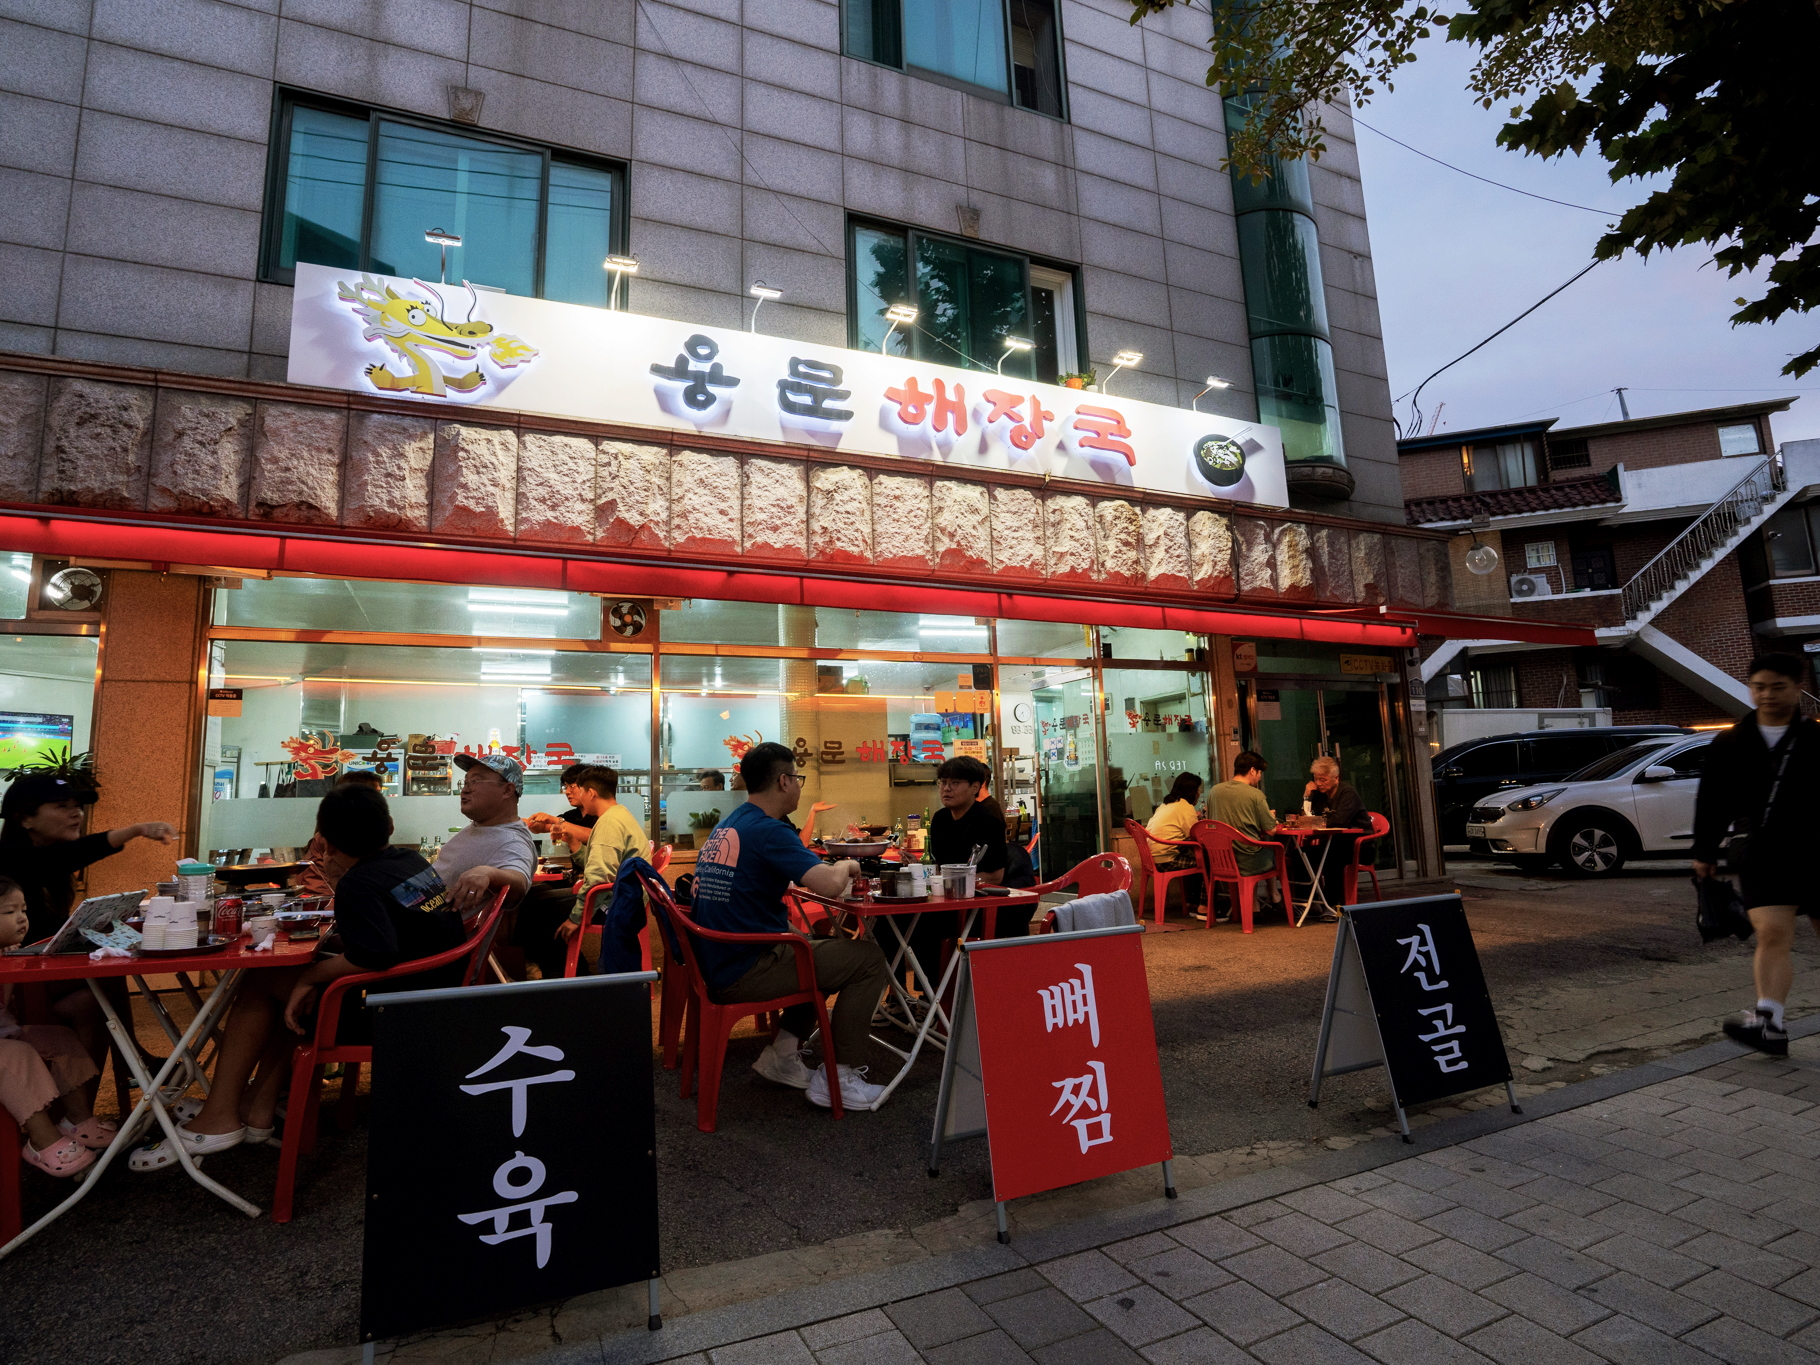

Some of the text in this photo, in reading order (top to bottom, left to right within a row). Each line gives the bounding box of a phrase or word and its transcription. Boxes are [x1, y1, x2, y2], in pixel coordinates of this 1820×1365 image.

[1411, 686, 1423, 695] 110
[420, 894, 445, 913] ocean
[1037, 962, 1114, 1155] 뼈찜
[1396, 923, 1469, 1073] 전골
[457, 1025, 579, 1269] 수육
